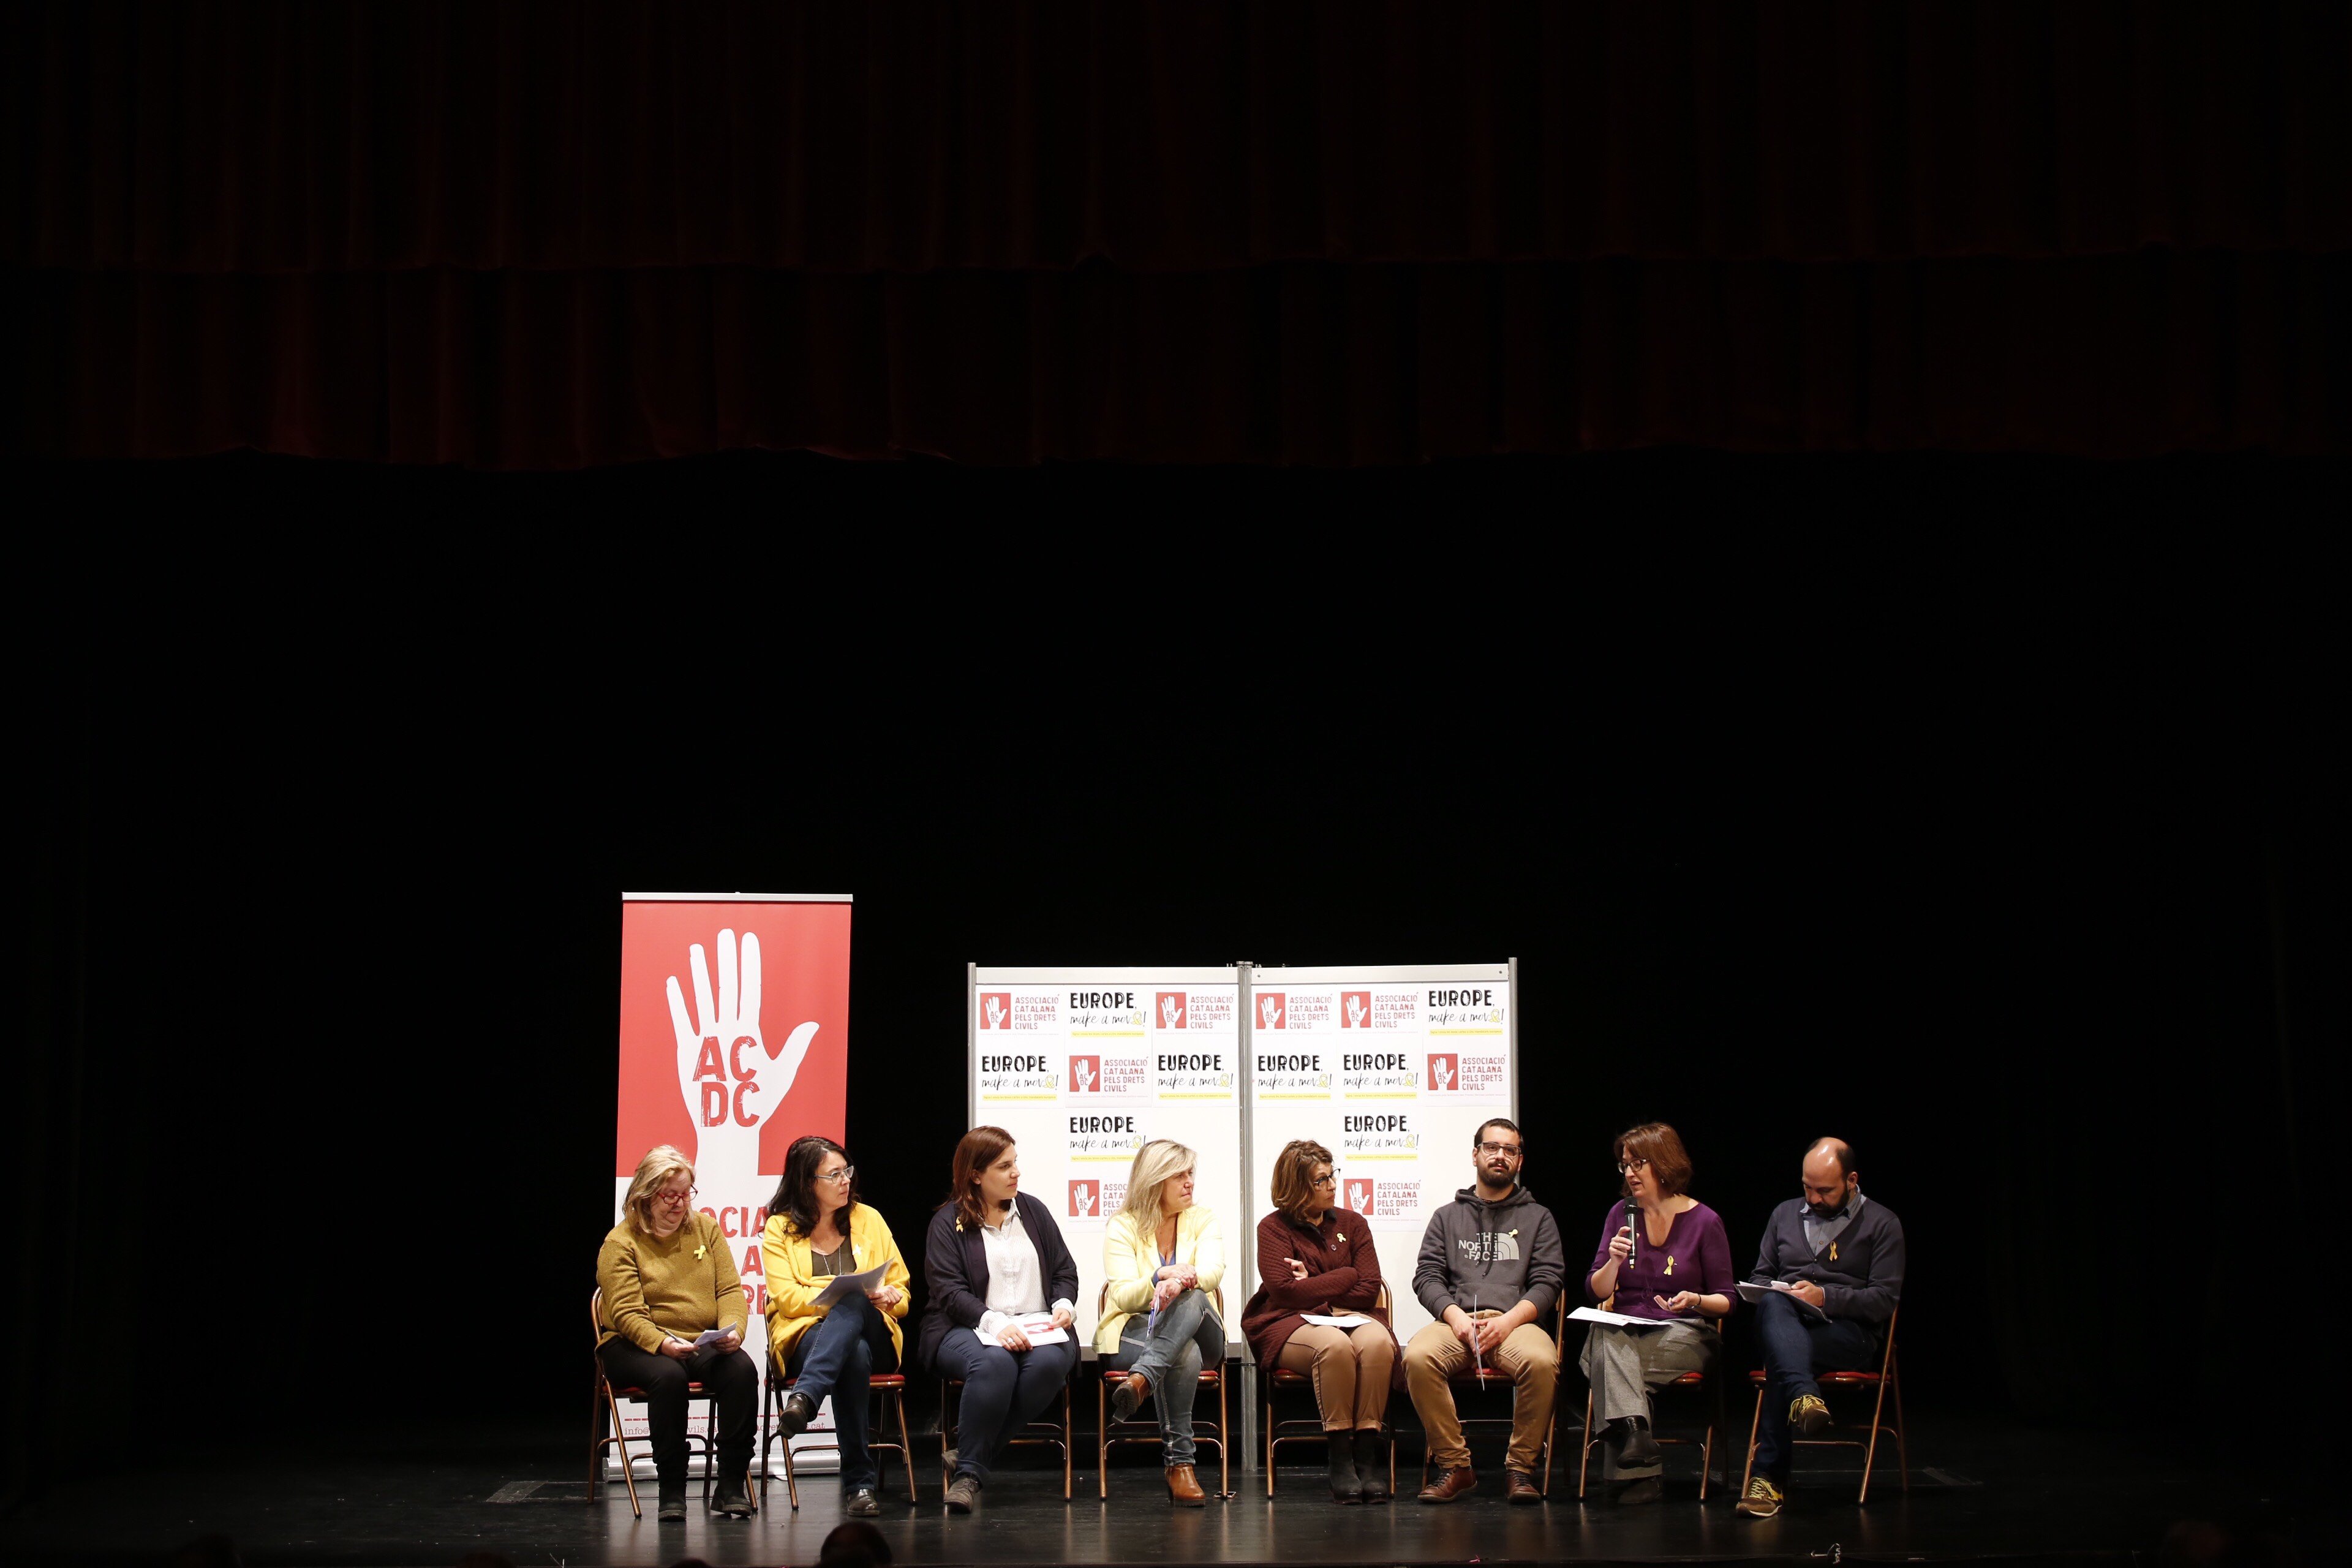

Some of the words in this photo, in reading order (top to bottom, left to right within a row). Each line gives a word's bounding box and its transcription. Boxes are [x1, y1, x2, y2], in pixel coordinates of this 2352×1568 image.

[1016, 994, 1060, 1004] ASSOCIACIÓ
[1191, 993, 1234, 1003] ASSOCIACIÓ
[1290, 993, 1333, 1003] ASSOCIACIÓ
[1375, 992, 1419, 1002] ASSOCIACIÓ
[1070, 1011, 1099, 1027] make
[1101, 1016, 1108, 1024] a
[1428, 1009, 1457, 1025] make
[1460, 1013, 1466, 1022] a
[692, 1036, 757, 1082] AC
[1104, 1056, 1148, 1066] ASSOCIACIÓ
[1462, 1054, 1506, 1065] ASSOCIACIÓ
[982, 1074, 1011, 1090] make
[1158, 1073, 1186, 1089] make
[1189, 1077, 1196, 1086] a
[1258, 1074, 1286, 1090] make
[1289, 1078, 1295, 1087] a
[1344, 1073, 1372, 1089] make
[701, 1081, 760, 1128] DC
[1070, 1136, 1098, 1152] make
[1101, 1140, 1107, 1148] a
[1344, 1134, 1372, 1150] make
[1375, 1139, 1382, 1147] a
[1378, 1180, 1421, 1189] ASSOCIACIÓ
